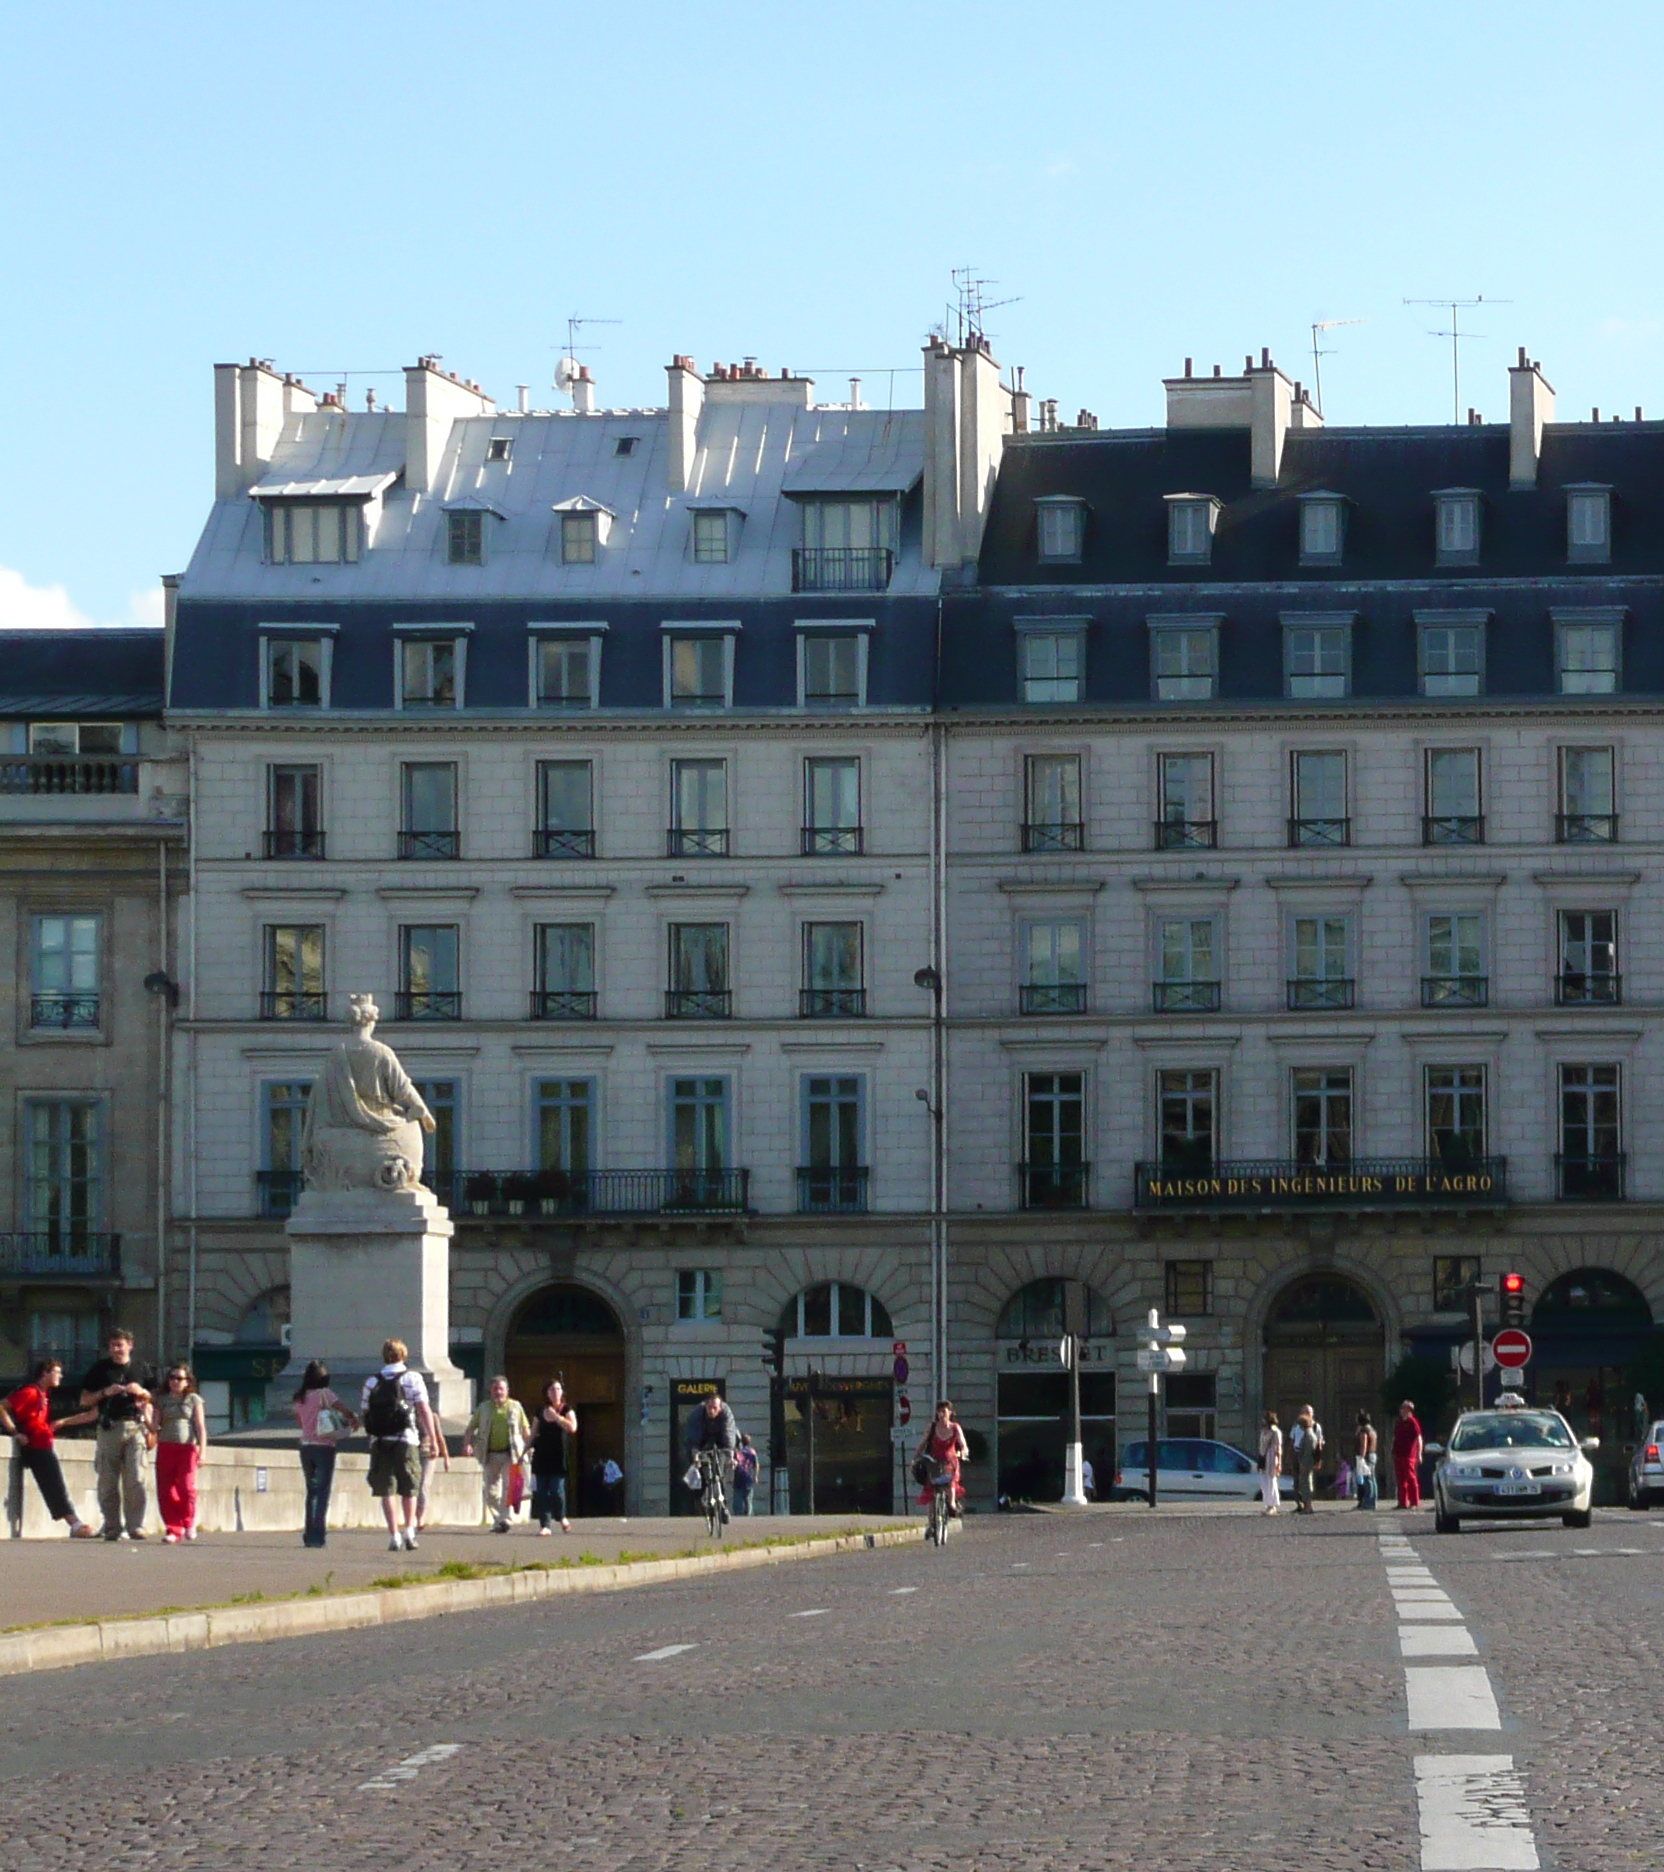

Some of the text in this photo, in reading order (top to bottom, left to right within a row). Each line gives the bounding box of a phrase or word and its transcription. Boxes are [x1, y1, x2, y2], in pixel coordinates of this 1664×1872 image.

[1149, 1178, 1221, 1197] MAISON
[1228, 1178, 1261, 1196] DES
[1396, 1176, 1417, 1193] DE
[1426, 1175, 1493, 1193] L'AGRO
